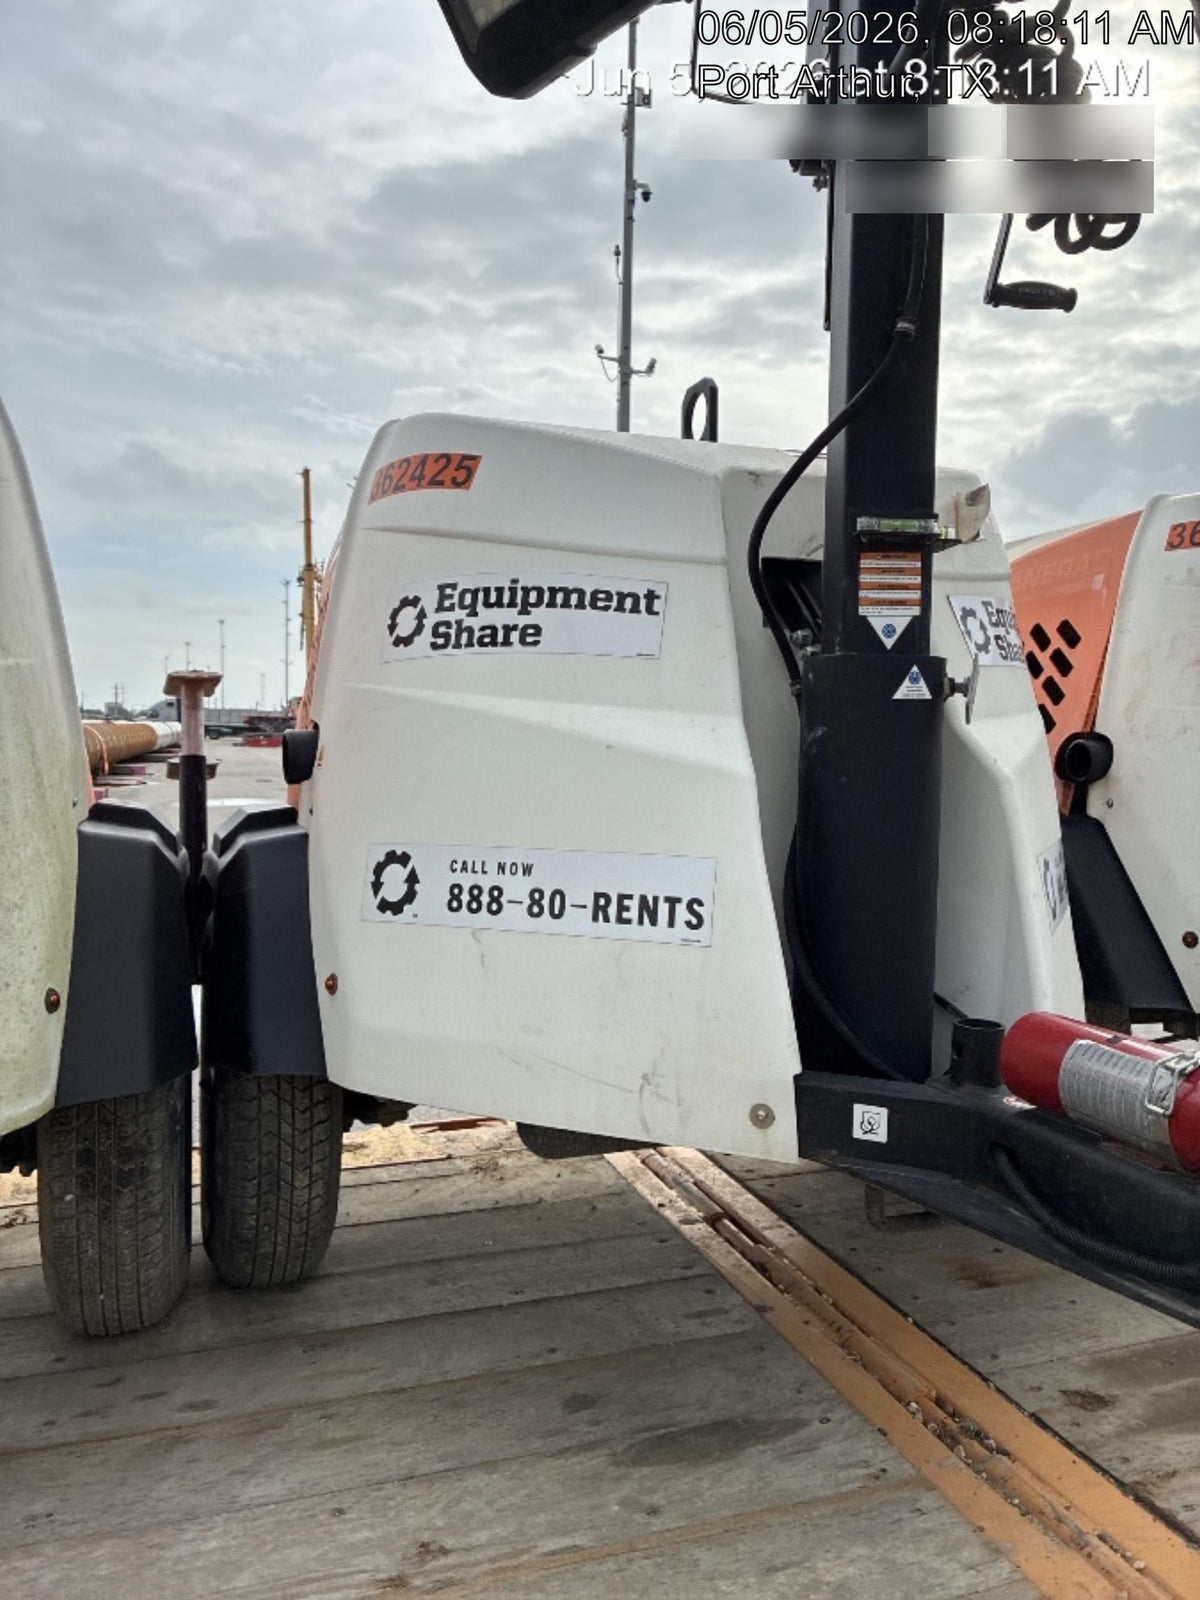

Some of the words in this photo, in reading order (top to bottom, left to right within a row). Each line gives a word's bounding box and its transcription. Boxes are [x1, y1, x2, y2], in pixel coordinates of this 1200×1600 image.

[434, 578, 661, 617] Equipment
[430, 620, 543, 651] Share
[450, 859, 488, 875] CALL
[497, 861, 534, 878] NOW
[447, 883, 705, 931] 888-80-RENTS
